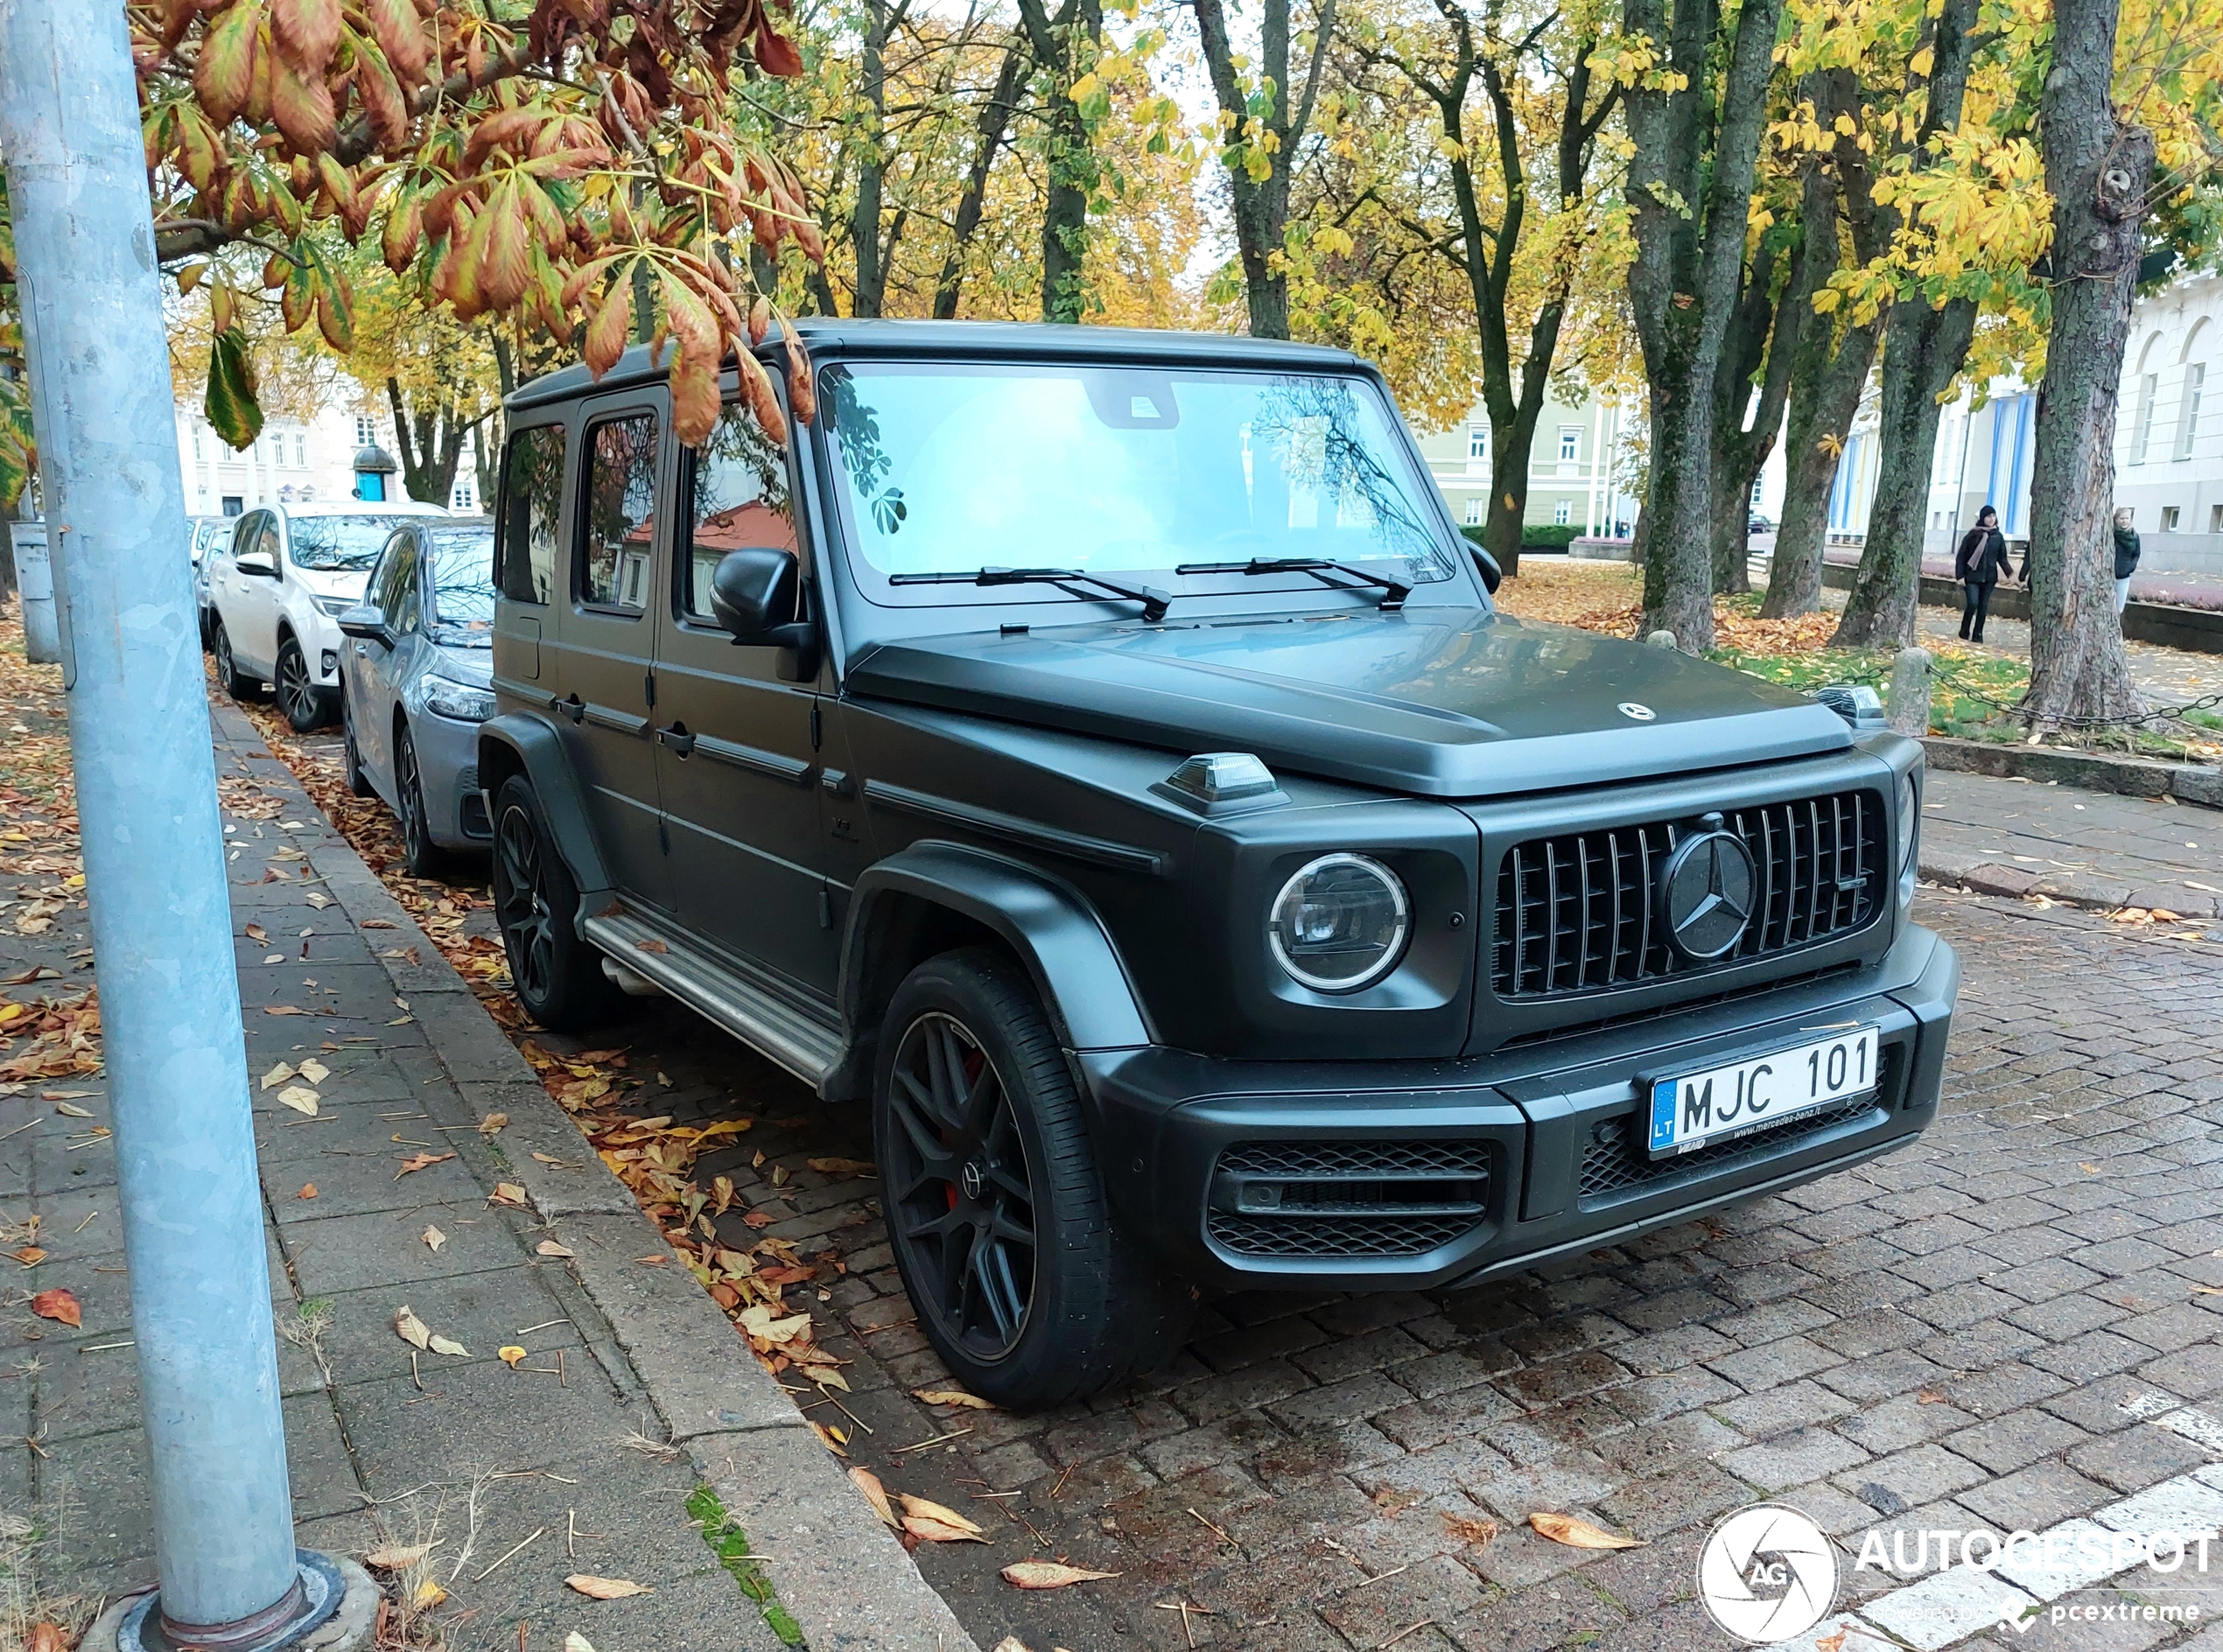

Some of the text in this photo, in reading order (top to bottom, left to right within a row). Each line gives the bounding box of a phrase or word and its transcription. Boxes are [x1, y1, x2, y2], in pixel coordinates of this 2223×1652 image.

[1684, 1036, 1868, 1134] MJC 101
[1654, 1119, 1673, 1138] LT
[1734, 1106, 1821, 1139] www.mercedes-benz.lt
